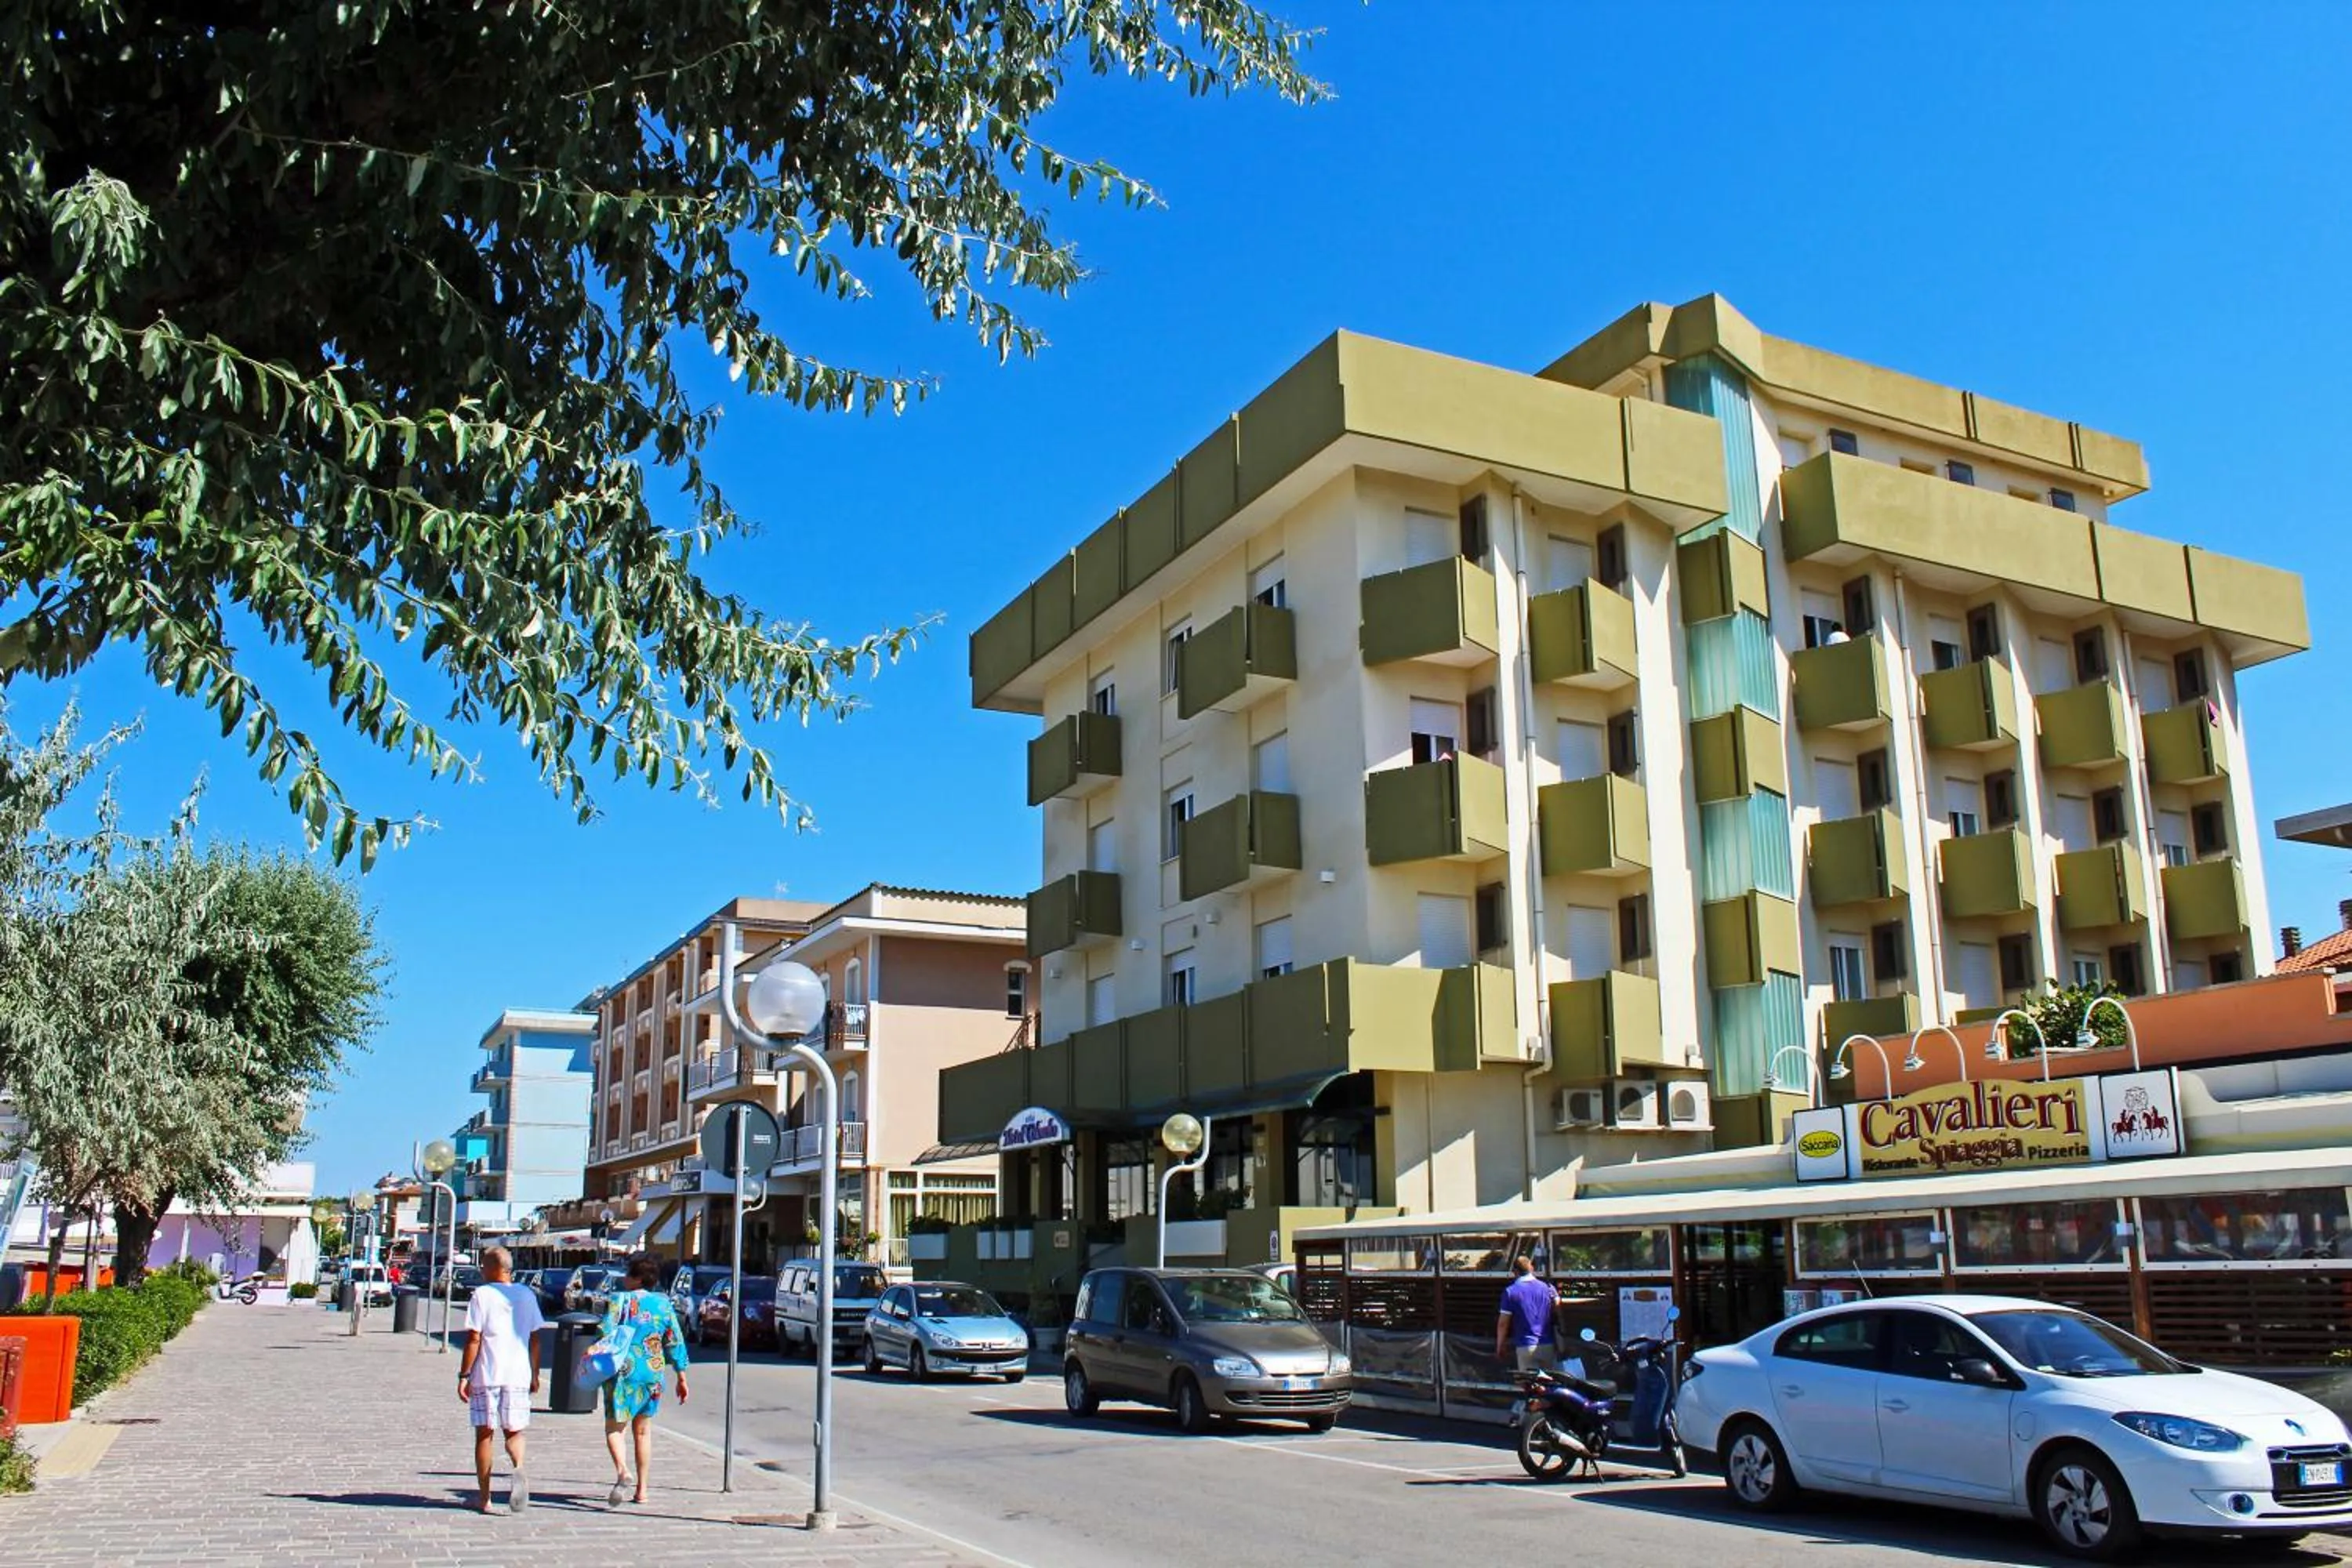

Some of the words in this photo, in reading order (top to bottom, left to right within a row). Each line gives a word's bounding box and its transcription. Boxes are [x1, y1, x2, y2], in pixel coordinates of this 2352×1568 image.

[1860, 1081, 2082, 1149] Cavalieri
[1919, 1133, 2024, 1170] Spiaggia
[2028, 1142, 2089, 1160] Pizzeria
